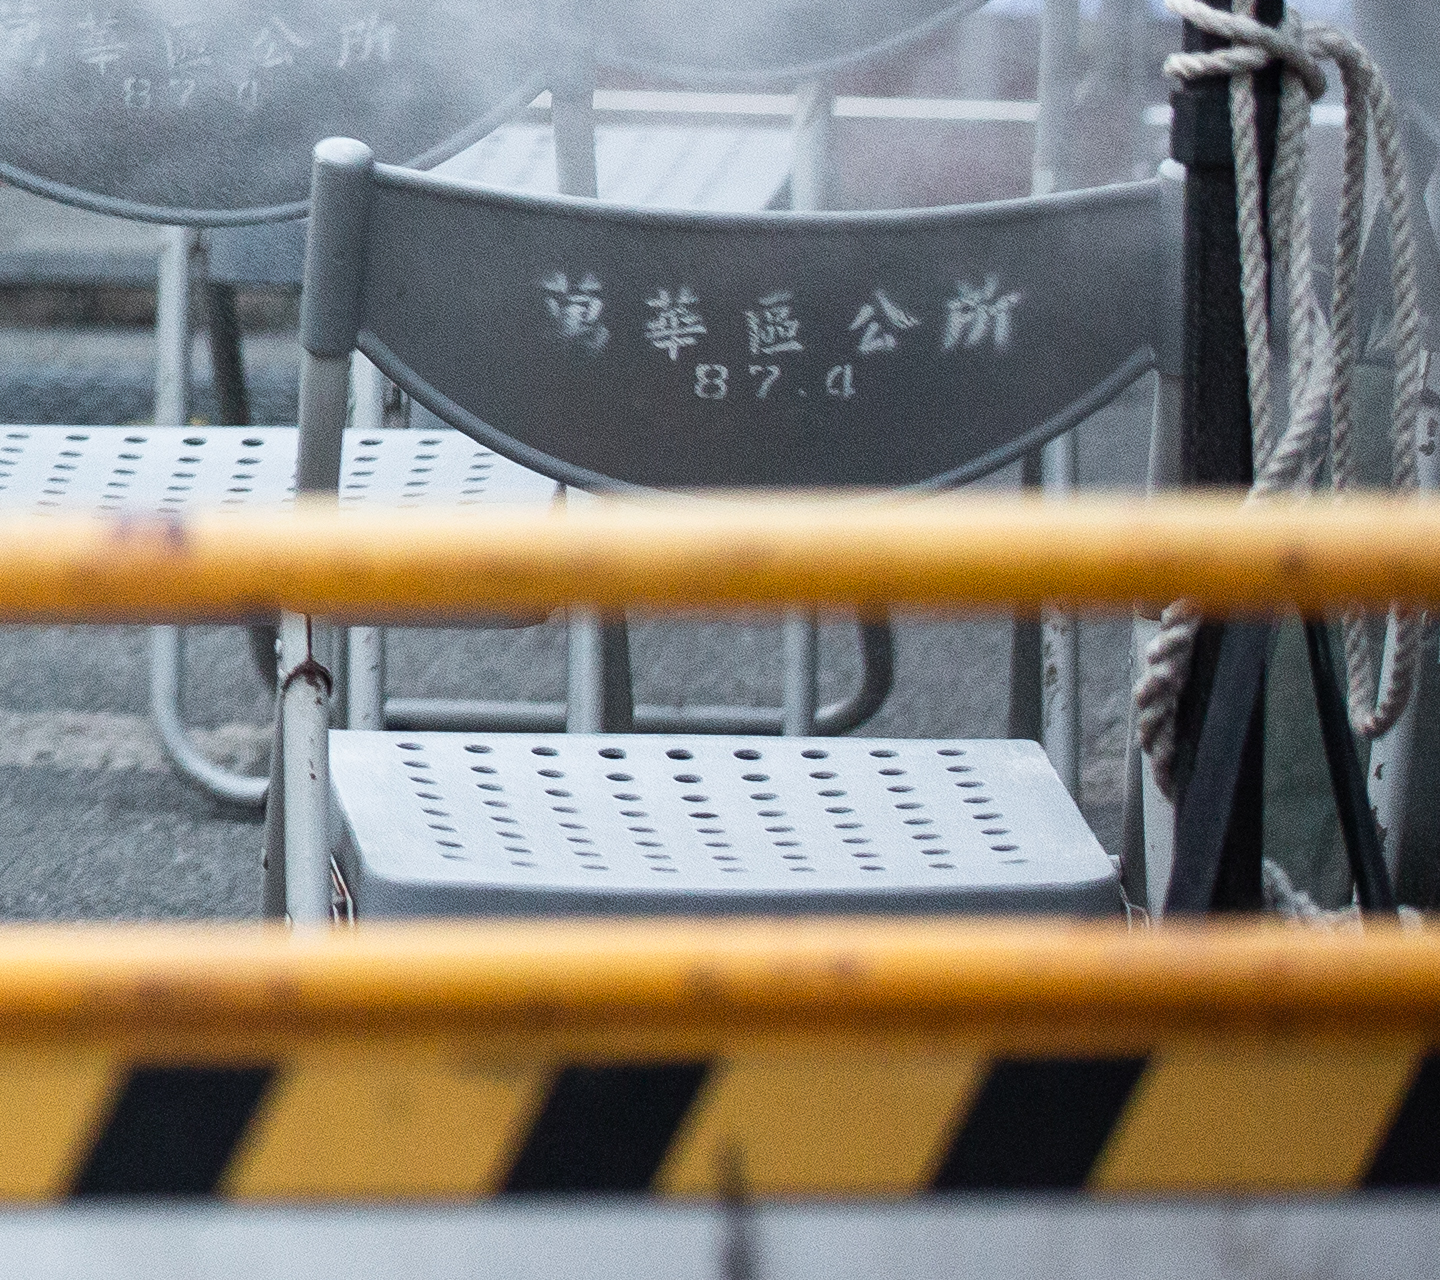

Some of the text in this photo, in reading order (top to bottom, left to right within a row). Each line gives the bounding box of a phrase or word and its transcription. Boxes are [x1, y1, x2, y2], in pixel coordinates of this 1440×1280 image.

[542, 272, 1022, 362] 萬華區公所
[692, 362, 857, 402] 87.4
